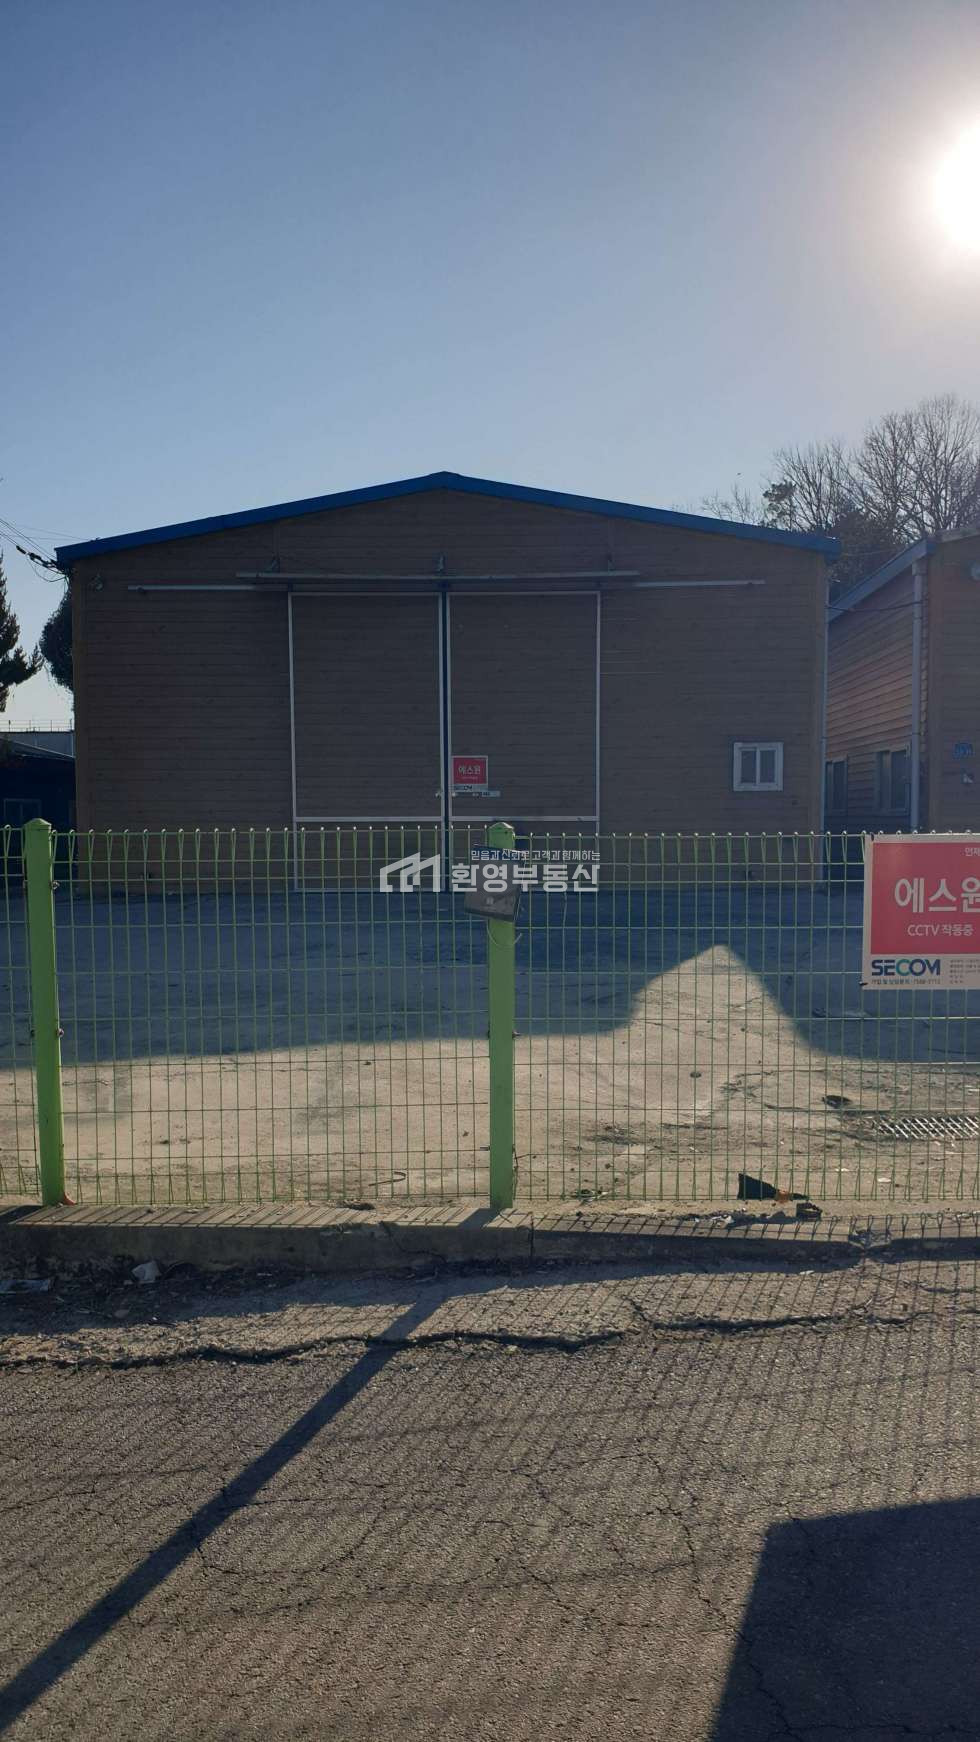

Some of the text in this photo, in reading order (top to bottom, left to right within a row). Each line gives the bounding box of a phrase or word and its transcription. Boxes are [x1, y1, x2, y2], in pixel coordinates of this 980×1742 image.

[894, 877, 980, 913] 에스원
[907, 923, 974, 937] CCTV 작동중
[871, 959, 941, 977] SECOM
